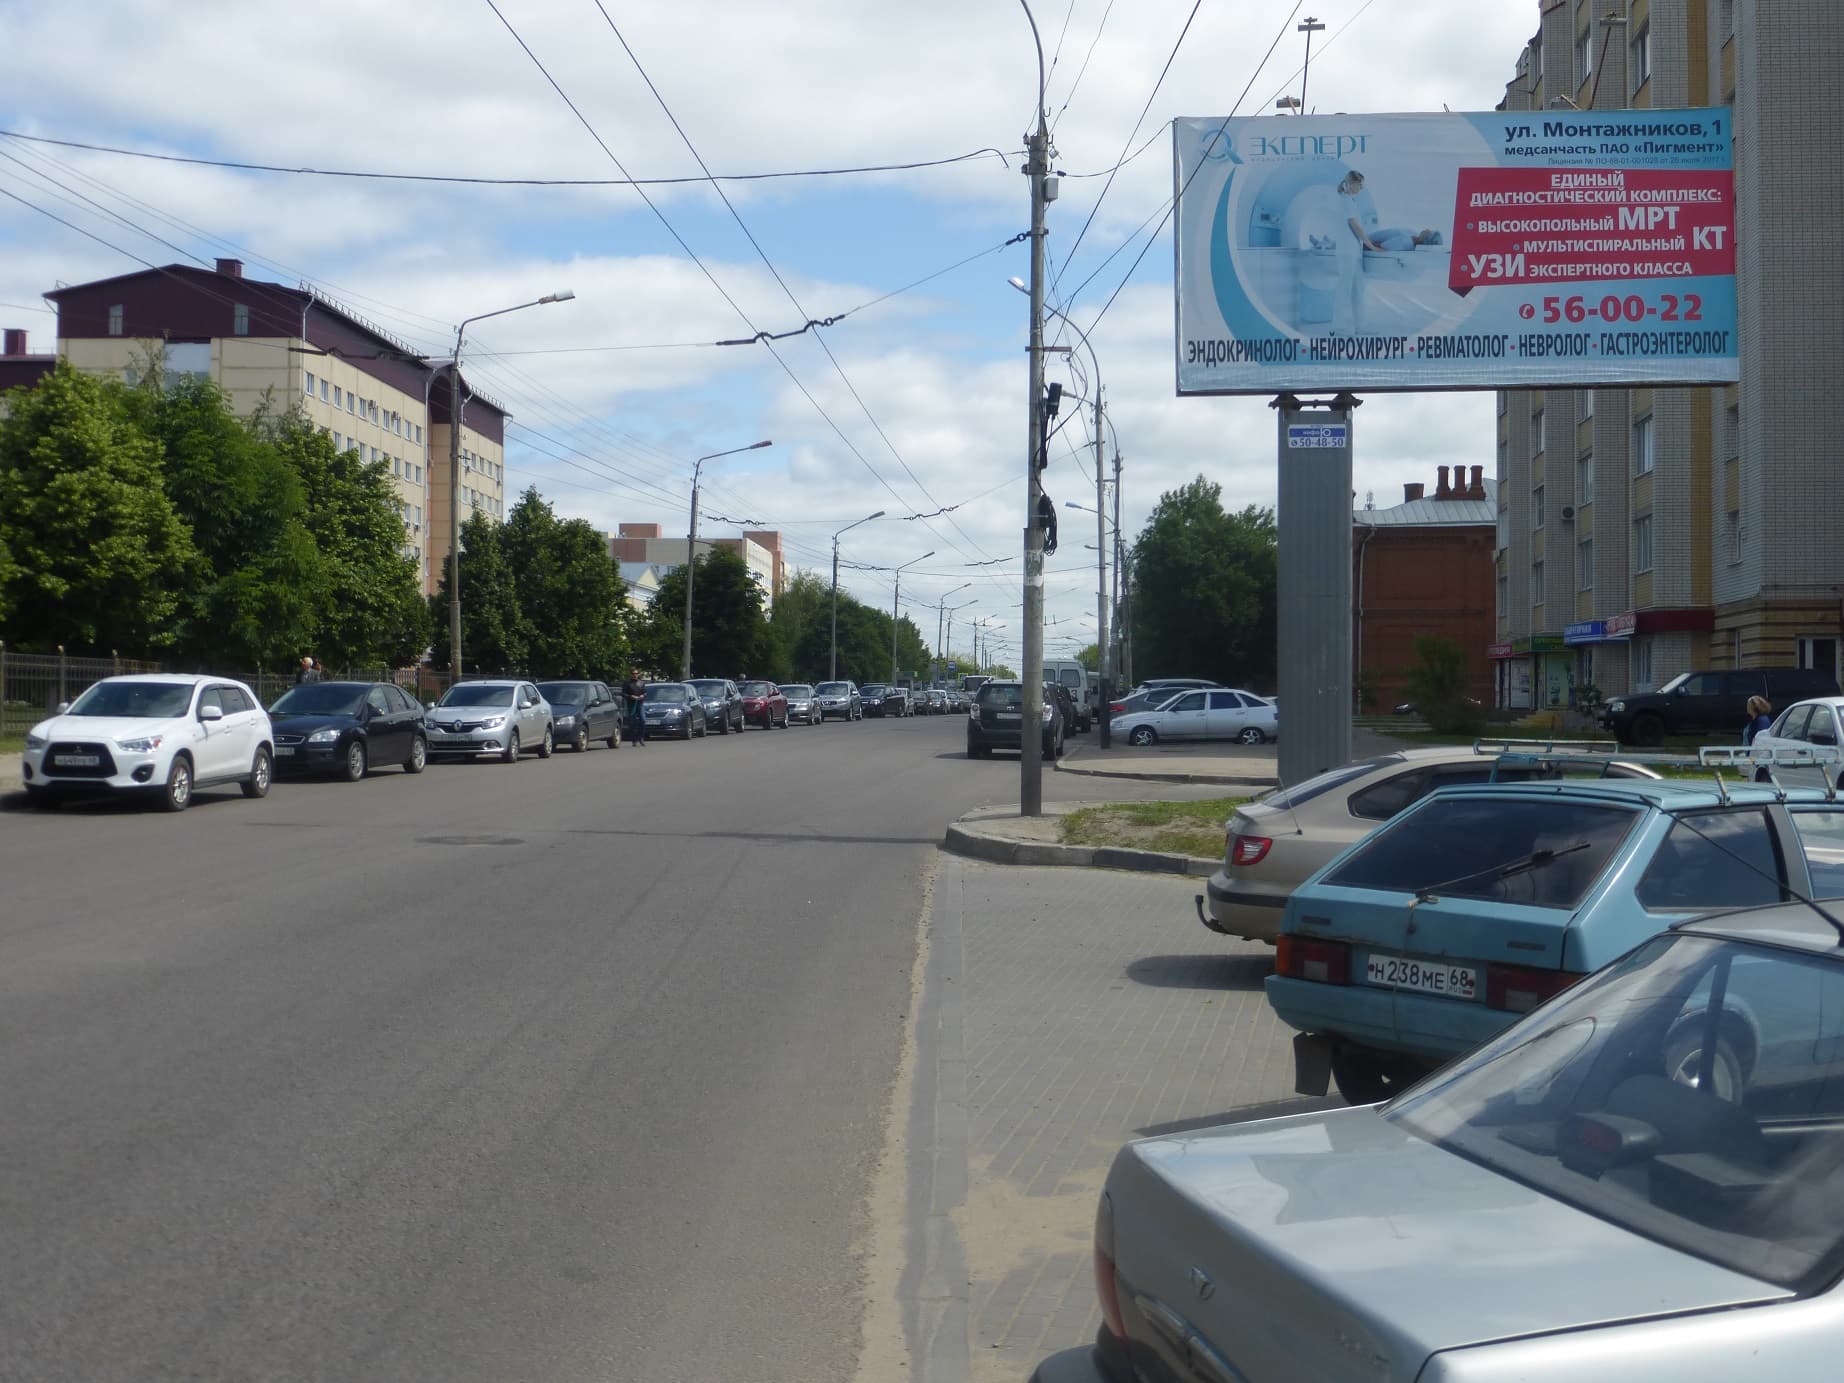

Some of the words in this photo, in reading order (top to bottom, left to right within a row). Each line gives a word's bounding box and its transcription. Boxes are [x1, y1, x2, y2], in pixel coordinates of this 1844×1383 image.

[1504, 125, 1536, 142] ул.
[1543, 121, 1708, 138] Монтажников,
[1712, 120, 1722, 136] 1
[1504, 145, 1597, 157] медсанчасть
[1600, 143, 1630, 154] ПАО
[1634, 141, 1725, 154] «Пигмент»
[1551, 170, 1625, 187] ЕДИНЫЙ
[1470, 187, 1627, 206] ДИАГНОСТИЧЕСКИЙ
[1630, 189, 1722, 202] КОМПЛЕКС:
[1478, 216, 1614, 233] ВЫСОКОПОЛЬНЫЙ
[1618, 206, 1680, 231] МРТ
[1523, 236, 1685, 253] МУЛЬТИСПИРАЛЬНЫЙ
[1693, 226, 1727, 250] КТ
[1468, 253, 1525, 278] УЗИ
[1529, 262, 1631, 277] ЭКСПЕРТНОГО
[1633, 262, 1693, 275] КЛАССА
[1543, 294, 1703, 323] 56-00-22
[1187, 338, 1301, 367] ЭНДОКРИНОЛОГ
[1309, 331, 1408, 361] НЕЙРОХИРУРГ
[1417, 335, 1509, 359] РЕВМАТОЛОГ
[1519, 333, 1591, 357] НЕВРОЛОГ
[1600, 331, 1730, 355] ГАСТРОЭНТЕРОЛОГ
